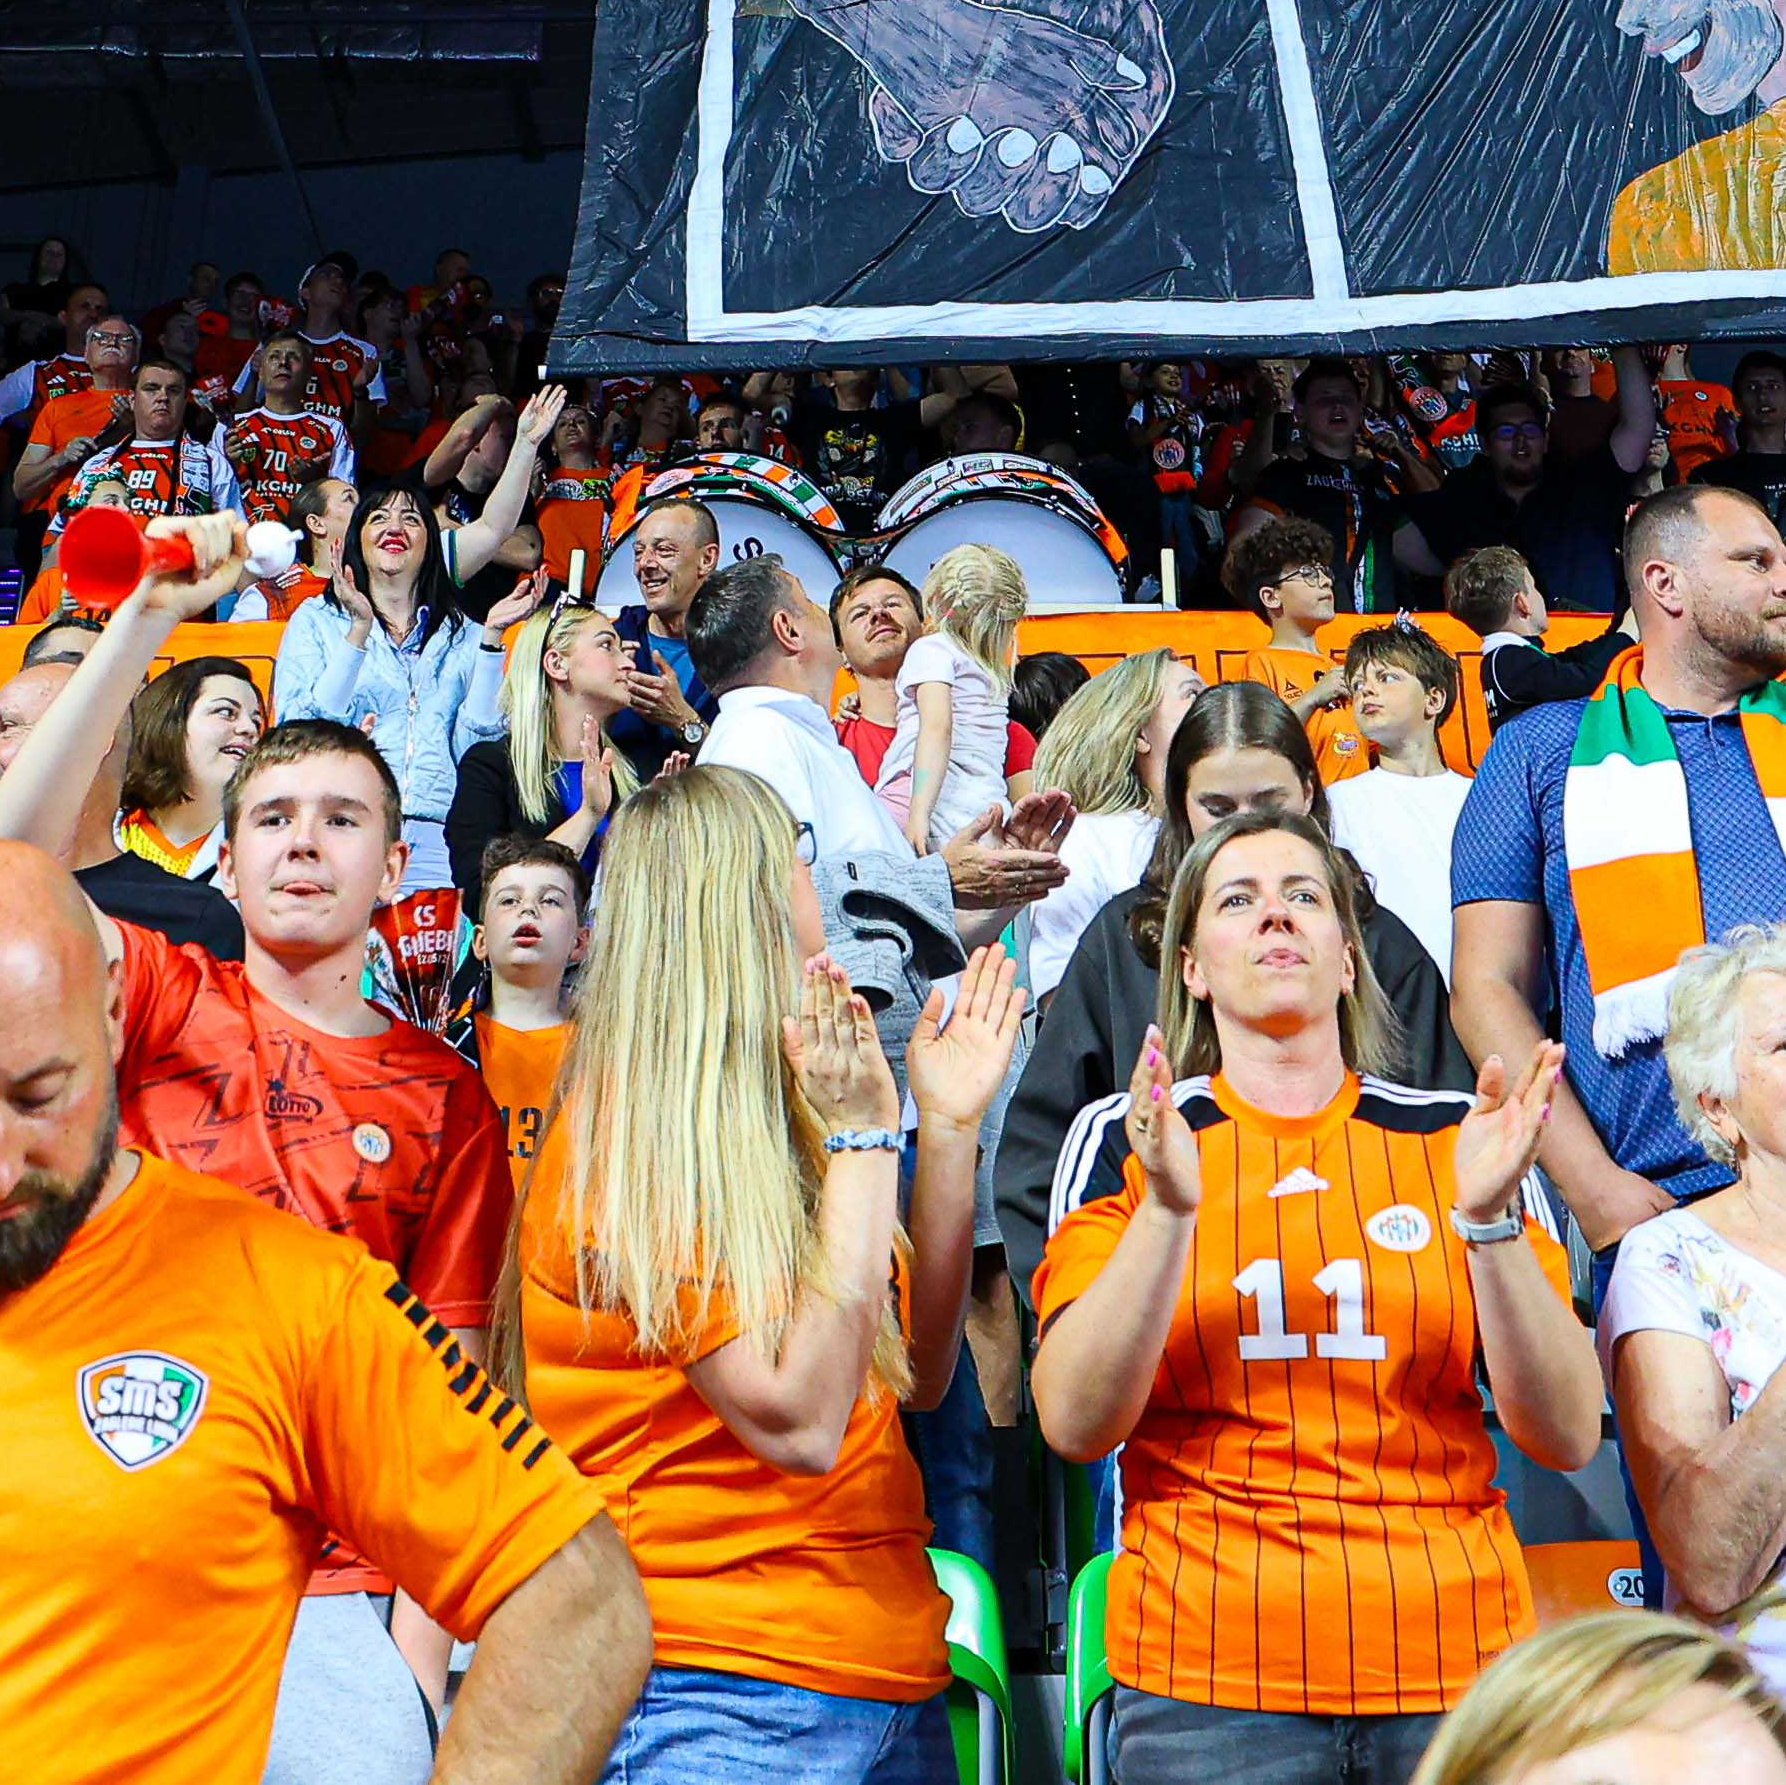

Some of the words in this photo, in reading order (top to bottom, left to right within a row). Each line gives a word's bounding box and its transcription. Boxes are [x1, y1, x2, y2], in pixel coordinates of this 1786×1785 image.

[263, 448, 288, 472] 70
[128, 469, 157, 489] 89
[1232, 1257, 1386, 1363] 11
